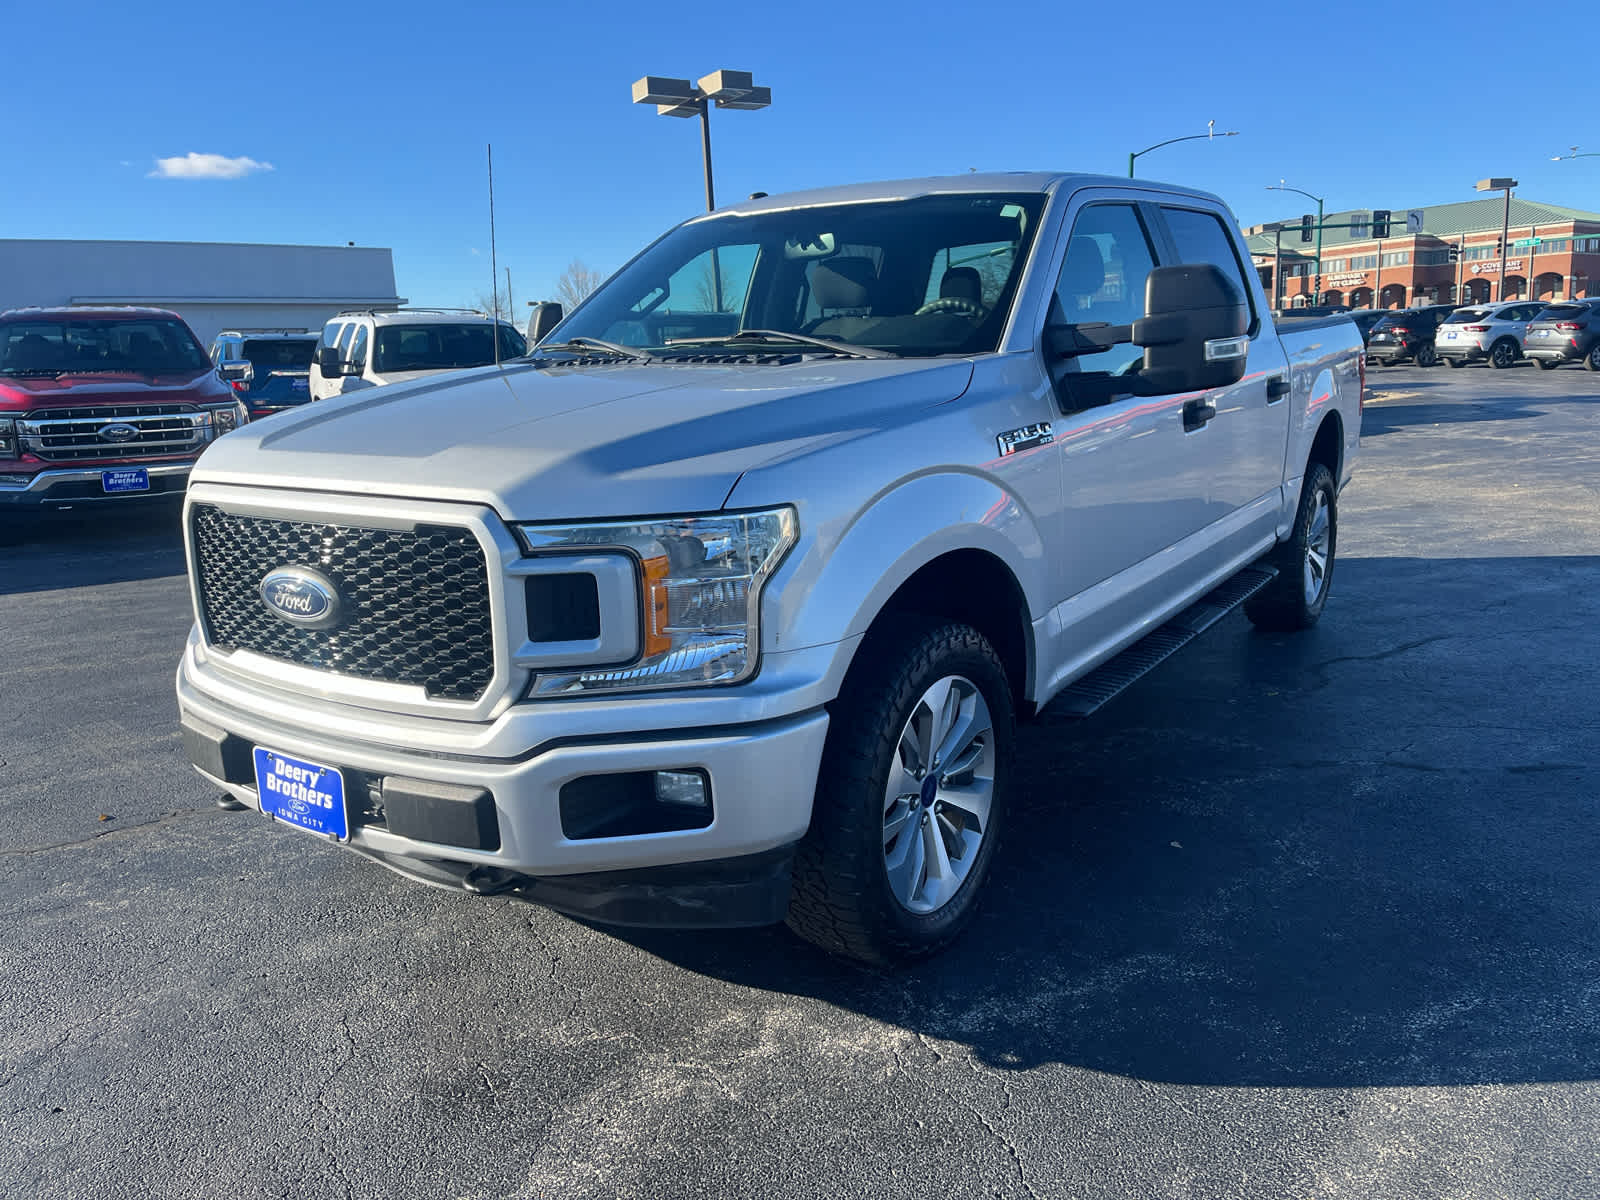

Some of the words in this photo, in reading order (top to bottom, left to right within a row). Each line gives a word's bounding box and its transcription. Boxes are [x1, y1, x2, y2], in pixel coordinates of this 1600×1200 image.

[1482, 260, 1522, 269] COVEANT
[108, 477, 144, 485] Brothers
[275, 584, 313, 612] Ford
[275, 758, 319, 788] Deery
[266, 772, 333, 809] Brothers
[278, 807, 299, 821] IOWA
[302, 816, 323, 829] CITY
